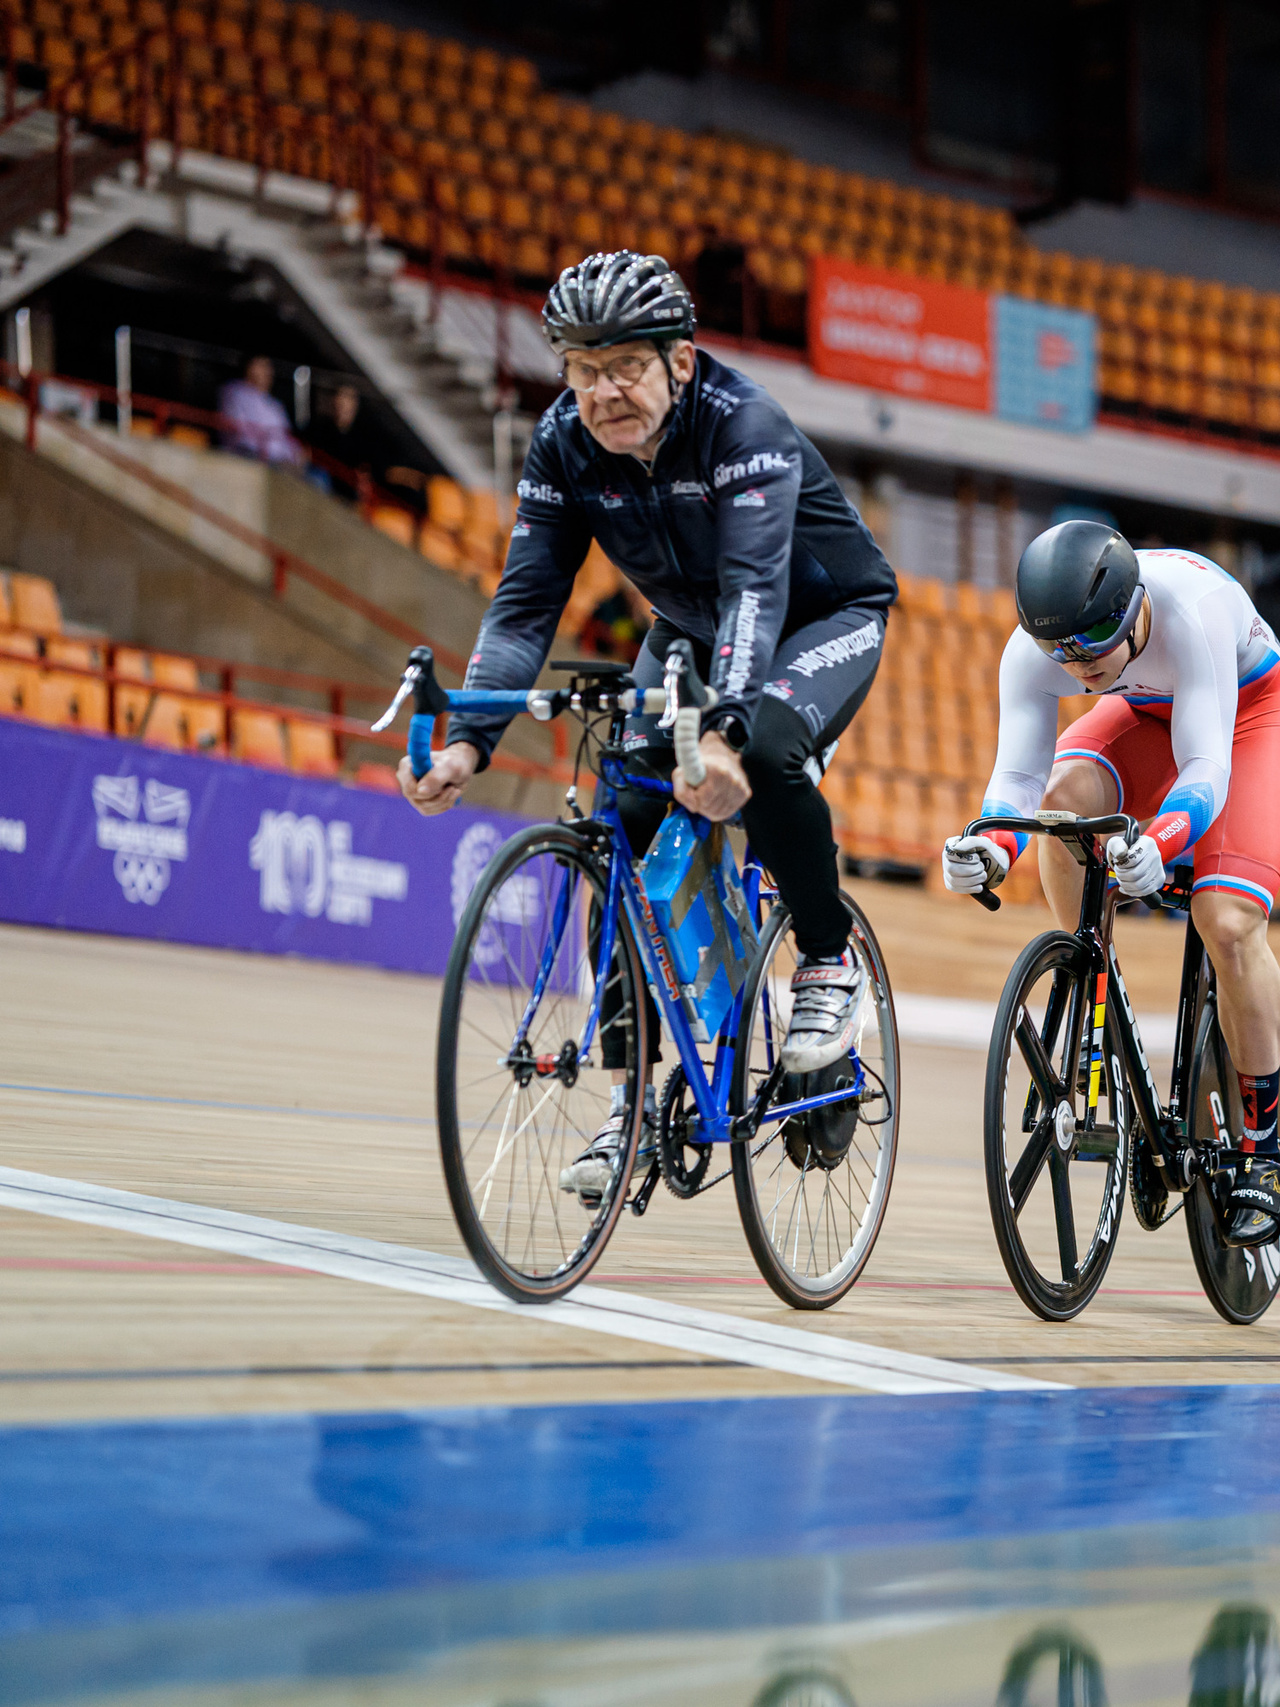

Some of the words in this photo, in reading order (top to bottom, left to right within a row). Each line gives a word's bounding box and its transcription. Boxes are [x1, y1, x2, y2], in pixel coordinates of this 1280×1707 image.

[1157, 817, 1189, 842] RUSSIA
[794, 970, 842, 984] TIME
[1100, 1053, 1128, 1243] CORIMA
[1231, 1188, 1274, 1205] Velobike
